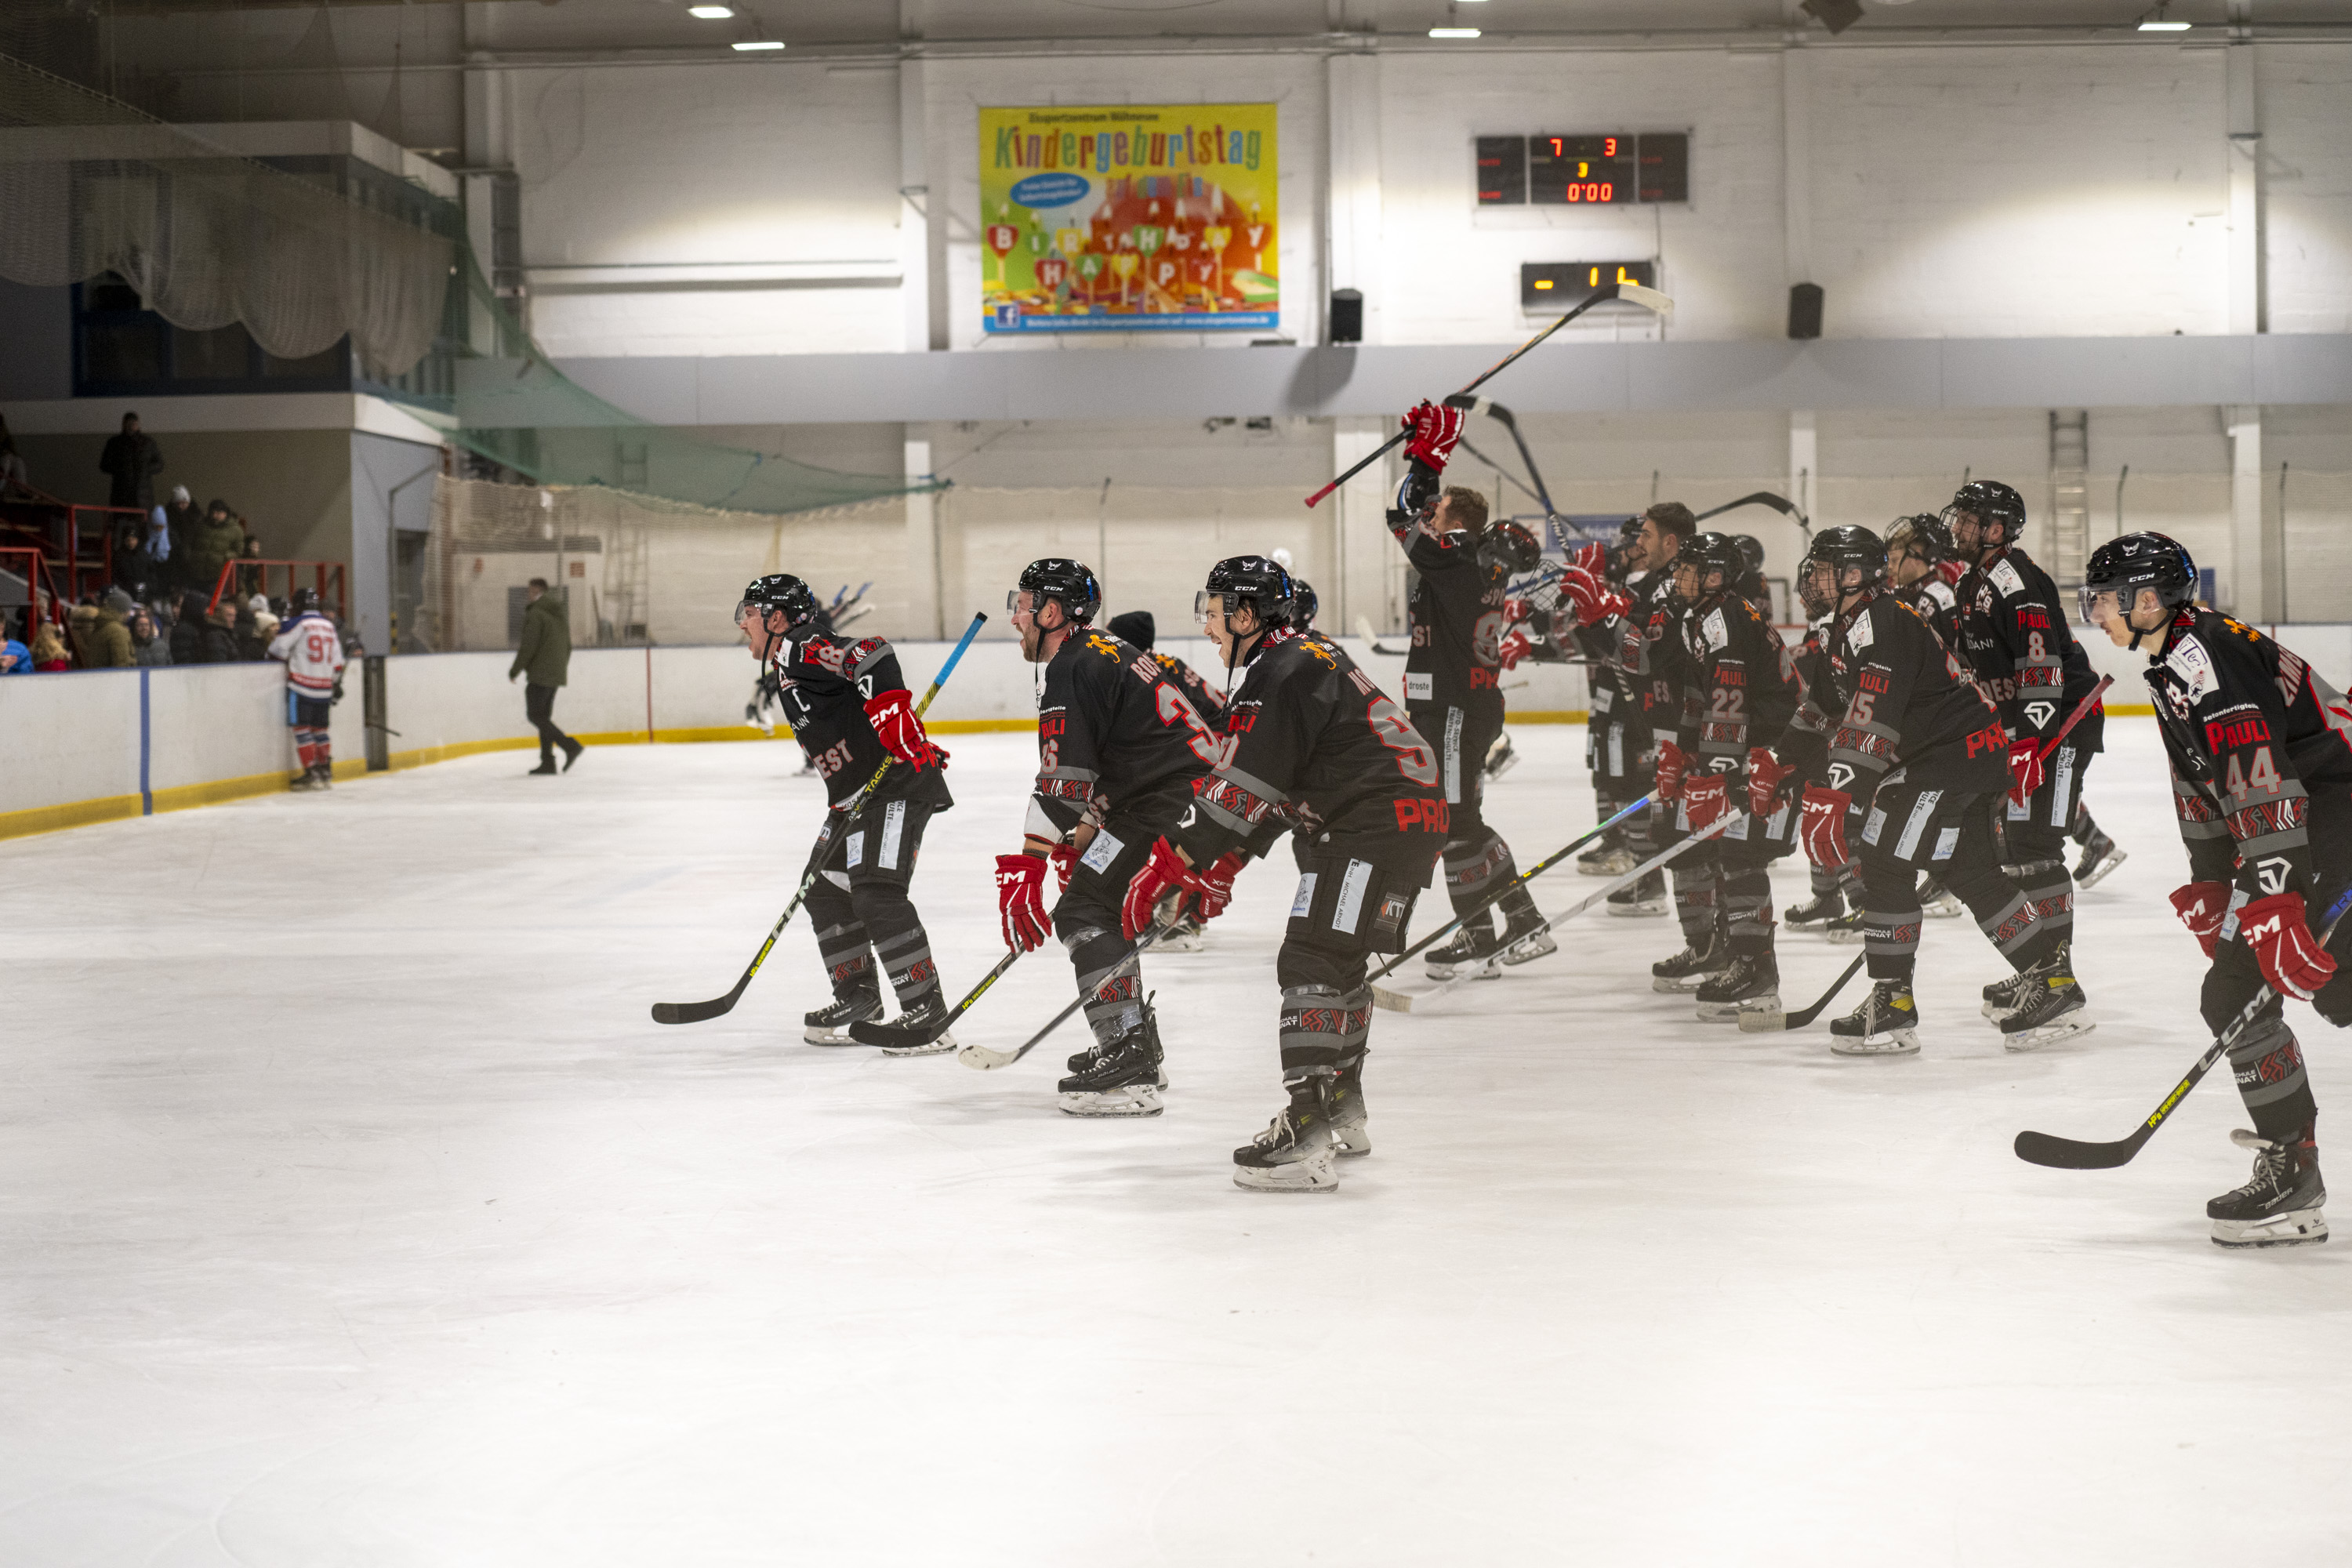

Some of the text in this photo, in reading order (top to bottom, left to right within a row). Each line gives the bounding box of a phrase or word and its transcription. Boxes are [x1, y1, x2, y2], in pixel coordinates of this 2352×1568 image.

[994, 124, 1262, 173] Kindergeburtstag
[1550, 138, 1617, 157] 7 3
[2128, 572, 2155, 583] CCM
[308, 635, 333, 664] 97
[2028, 630, 2046, 662] 8
[792, 688, 811, 712] C
[1409, 681, 1429, 691] droste
[1711, 688, 1744, 720] 22
[2205, 720, 2271, 756] PAULI
[811, 738, 854, 780] EST
[865, 755, 893, 793] TACKS
[2057, 748, 2067, 779] SCHULTE
[2226, 746, 2282, 803] 44
[771, 872, 816, 940] CCM
[1339, 881, 1350, 906] MICHAEL
[1334, 908, 1344, 928] ARNDT
[2198, 983, 2271, 1073] CCM
